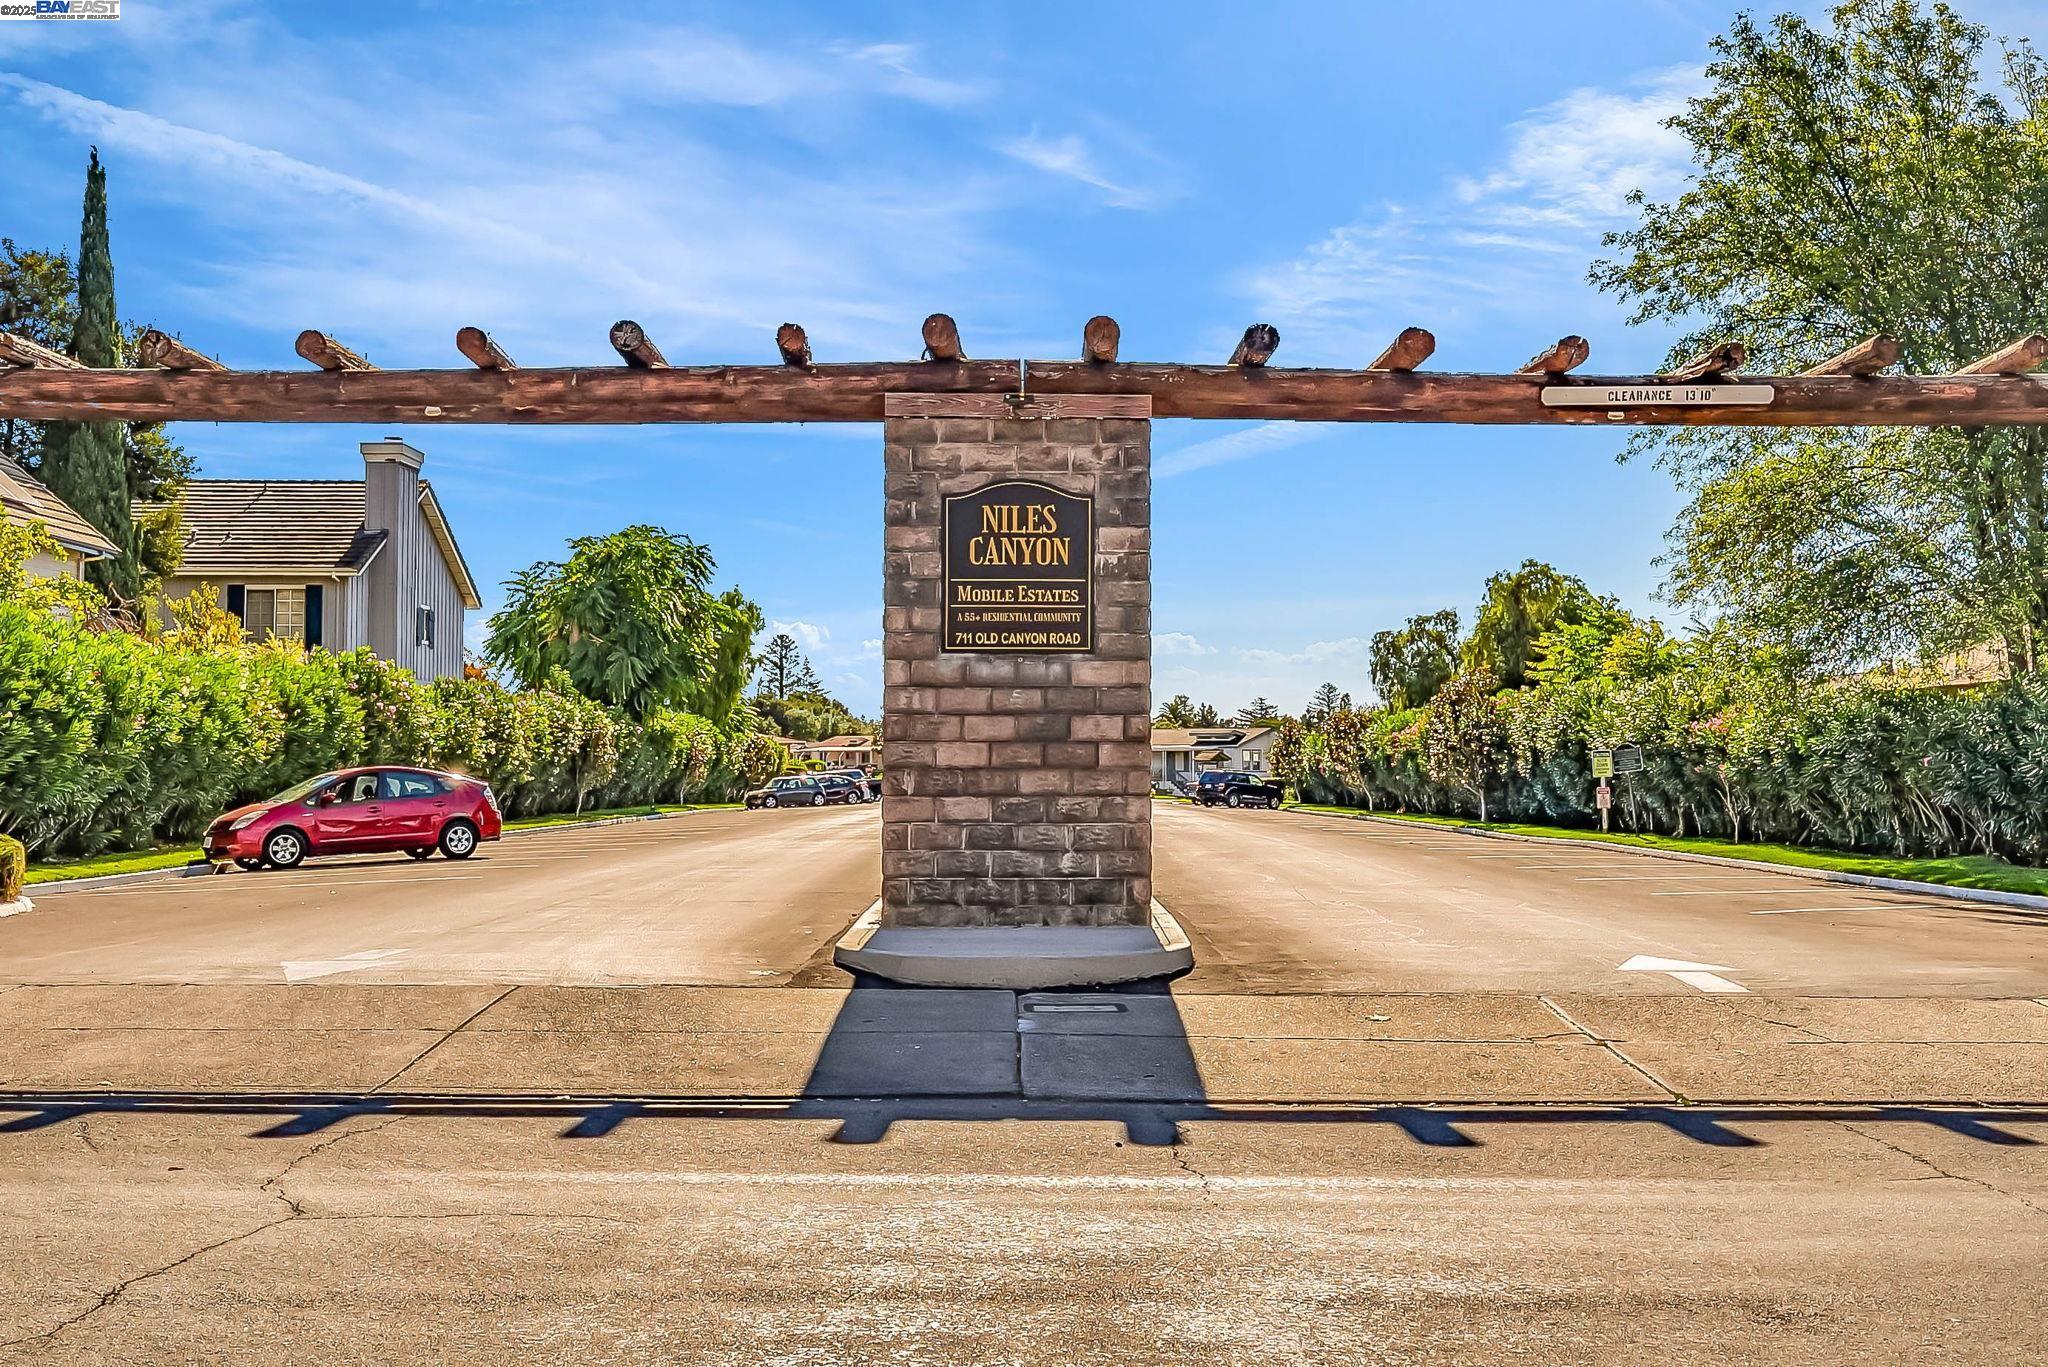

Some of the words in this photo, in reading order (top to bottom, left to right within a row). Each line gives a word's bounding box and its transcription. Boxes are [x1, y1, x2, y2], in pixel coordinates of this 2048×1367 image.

[1608, 390, 1672, 401] CLEARANCE
[981, 504, 1058, 534] NILES
[969, 536, 1071, 566] CANYON
[957, 613, 963, 622] A
[964, 613, 981, 622] 55+
[982, 613, 1033, 622] RESIDENTIAL
[1033, 613, 1082, 622] COMMUNITY
[955, 633, 973, 644] 711
[975, 633, 998, 644] OLD
[1001, 633, 1047, 644] CANYON
[1049, 633, 1081, 644] ROAD
